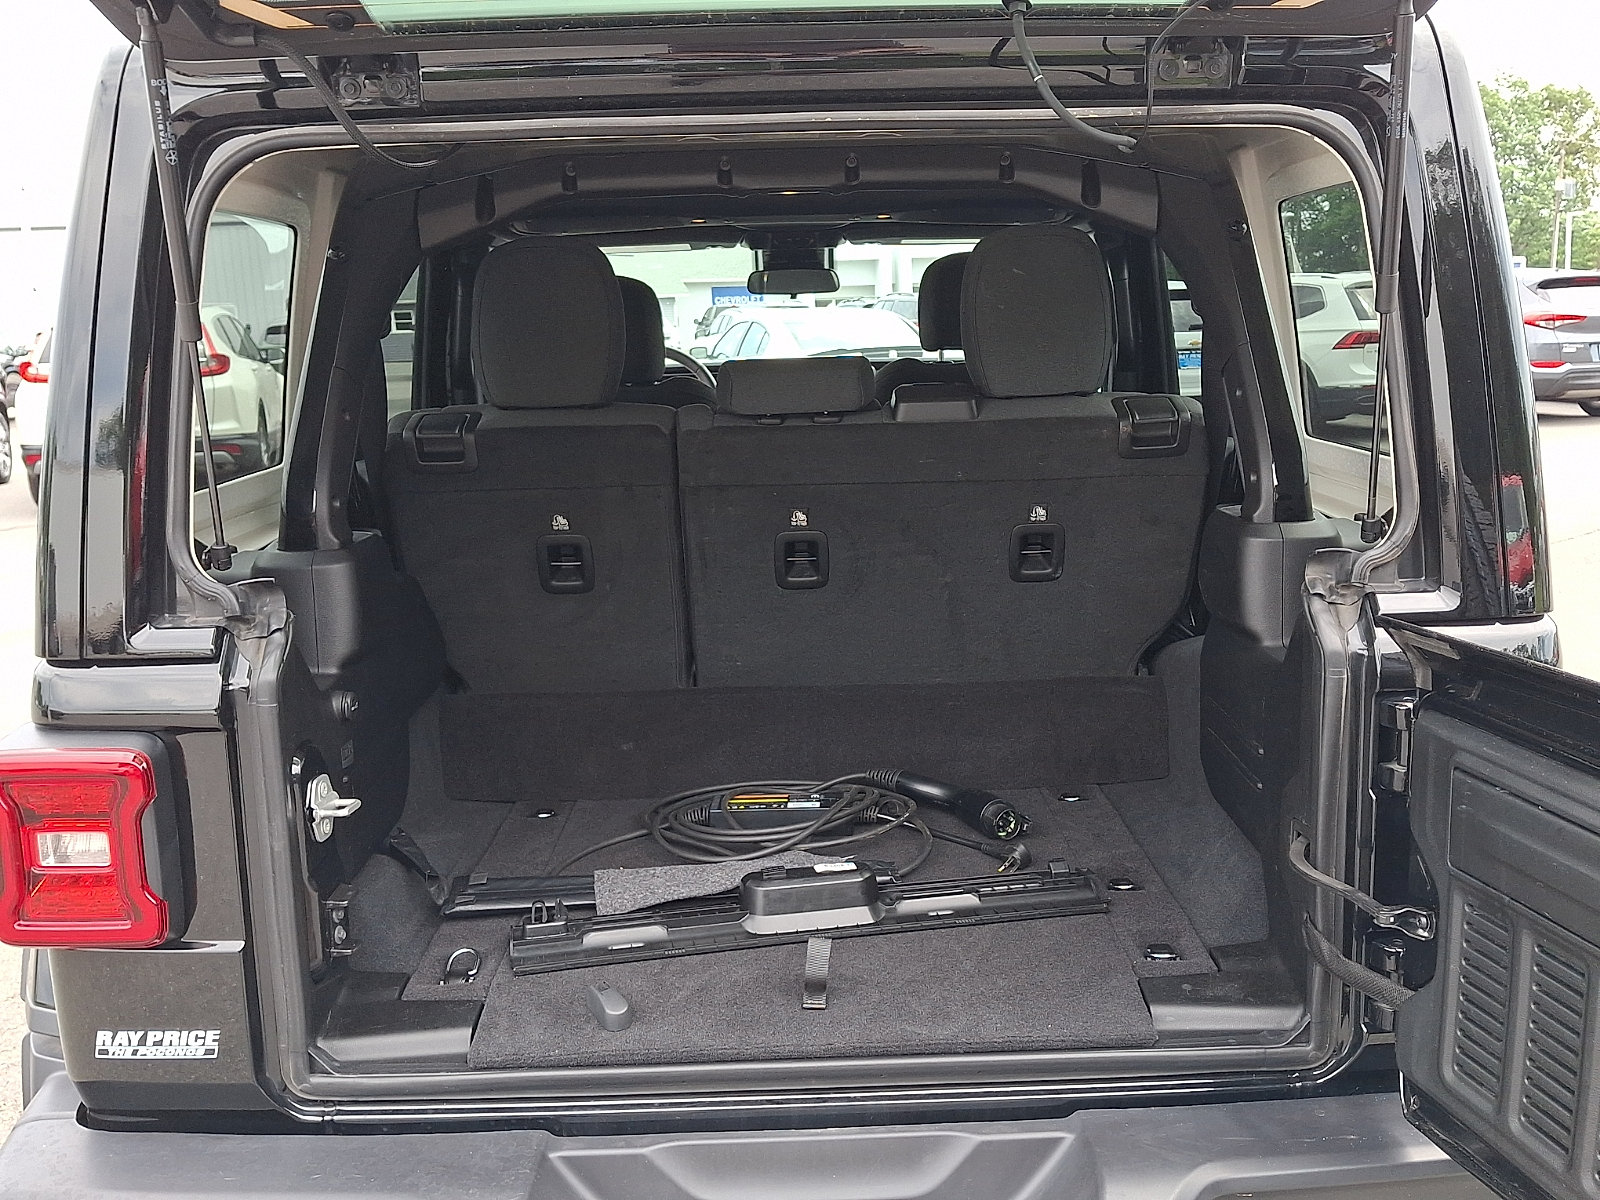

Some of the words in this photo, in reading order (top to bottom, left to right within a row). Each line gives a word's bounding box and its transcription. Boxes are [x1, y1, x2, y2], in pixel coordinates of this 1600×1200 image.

[155, 100, 167, 149] STABILUS
[714, 295, 764, 305] CHEVROLET
[95, 1030, 145, 1046] RAY
[145, 1030, 221, 1046] PRICE
